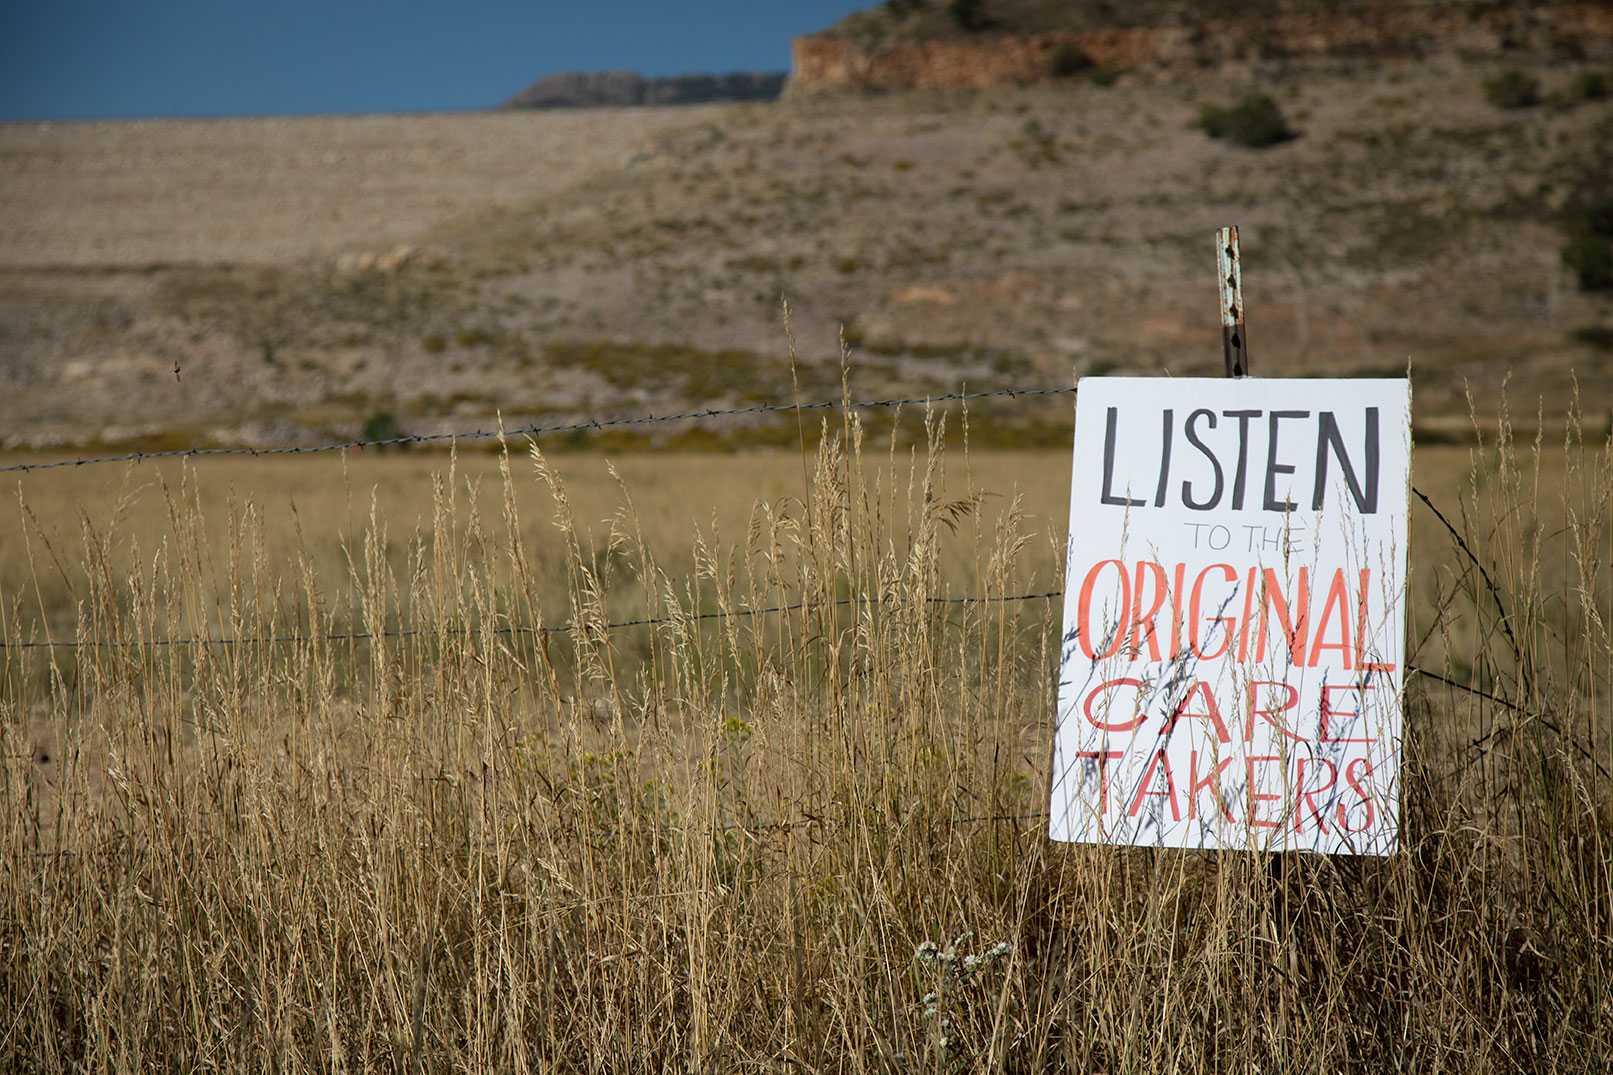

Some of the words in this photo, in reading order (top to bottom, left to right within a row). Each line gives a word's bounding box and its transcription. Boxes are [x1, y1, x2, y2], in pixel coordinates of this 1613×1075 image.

[1101, 407, 1379, 514] LISTEN
[1184, 522, 1231, 550] TO
[1242, 525, 1306, 552] THE
[1077, 559, 1396, 672] ORIGINAL
[1083, 677, 1377, 743] CARE
[1075, 750, 1375, 836] TAKERS
